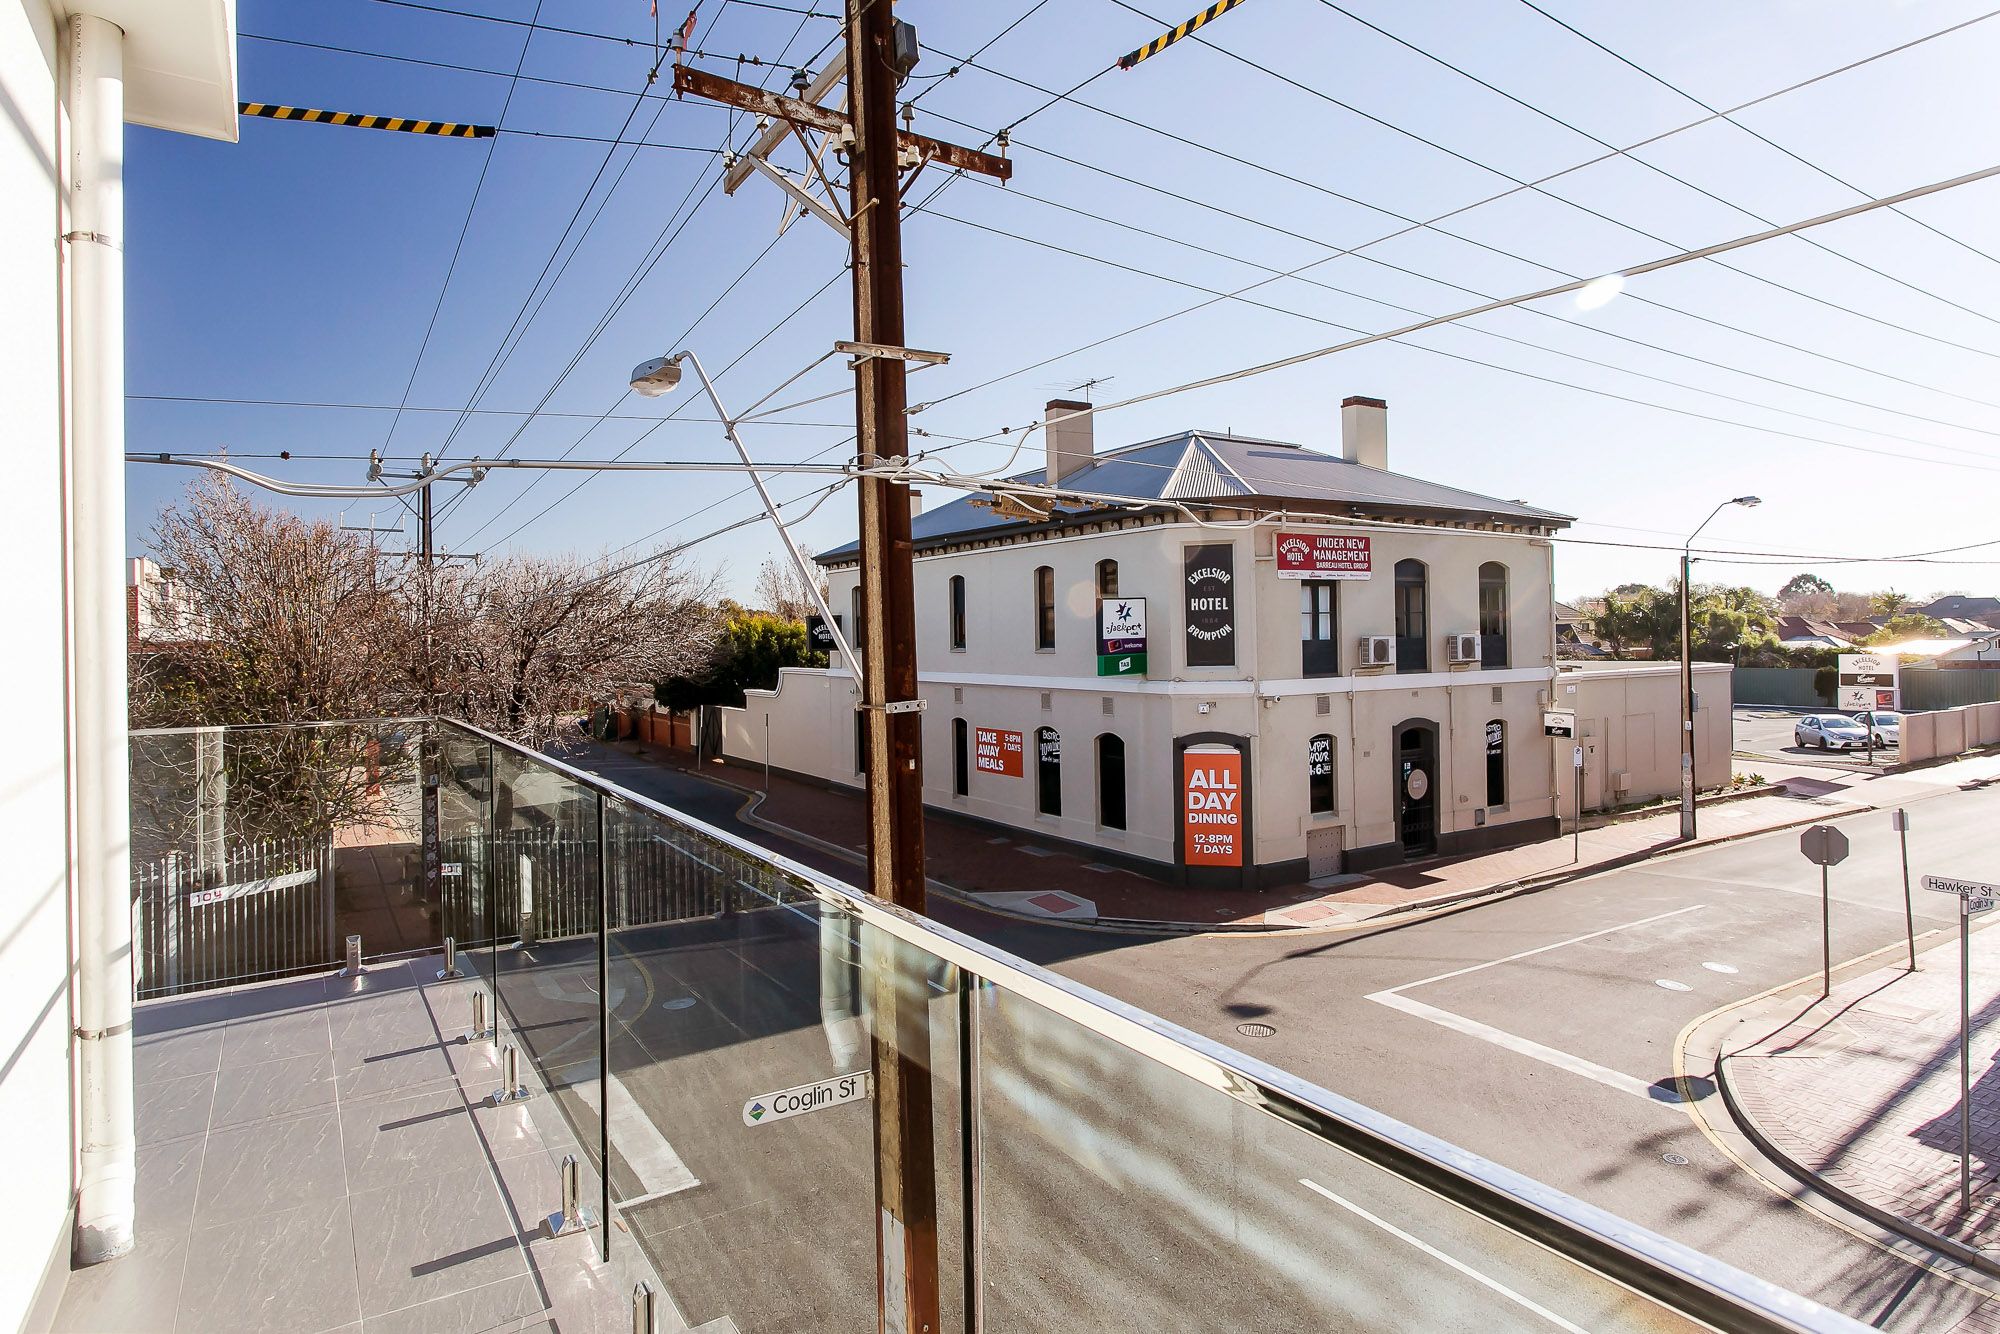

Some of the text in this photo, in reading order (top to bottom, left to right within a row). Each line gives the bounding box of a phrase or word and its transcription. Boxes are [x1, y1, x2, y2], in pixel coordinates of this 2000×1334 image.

[1280, 538, 1310, 554] EXCELSIOR
[1316, 537, 1365, 549] UNDER NEW
[1286, 552, 1304, 561] HOTEL
[1313, 549, 1369, 561] MANAGEMENT
[1353, 562, 1369, 570] GROUP
[1187, 567, 1231, 585] EXCELSIOR
[1190, 597, 1229, 611] HOTEL
[812, 623, 830, 636] EXCEL
[1187, 623, 1233, 641] BROMPTON
[977, 731, 997, 744] TAKE
[1004, 733, 1021, 743] 5-8PM
[977, 745, 1000, 757] AWAY
[1007, 743, 1021, 752] DAYS
[978, 756, 1004, 771] MEALS
[1188, 769, 1237, 789] ALL
[1188, 791, 1237, 810] DAY
[1188, 813, 1238, 825] DINING
[1193, 834, 1233, 844] 12-8PM
[1194, 844, 1233, 854] 7 DAYS
[1928, 877, 1993, 897] Hawker St
[196, 889, 222, 903] 104
[773, 1077, 857, 1114] Coglin St
